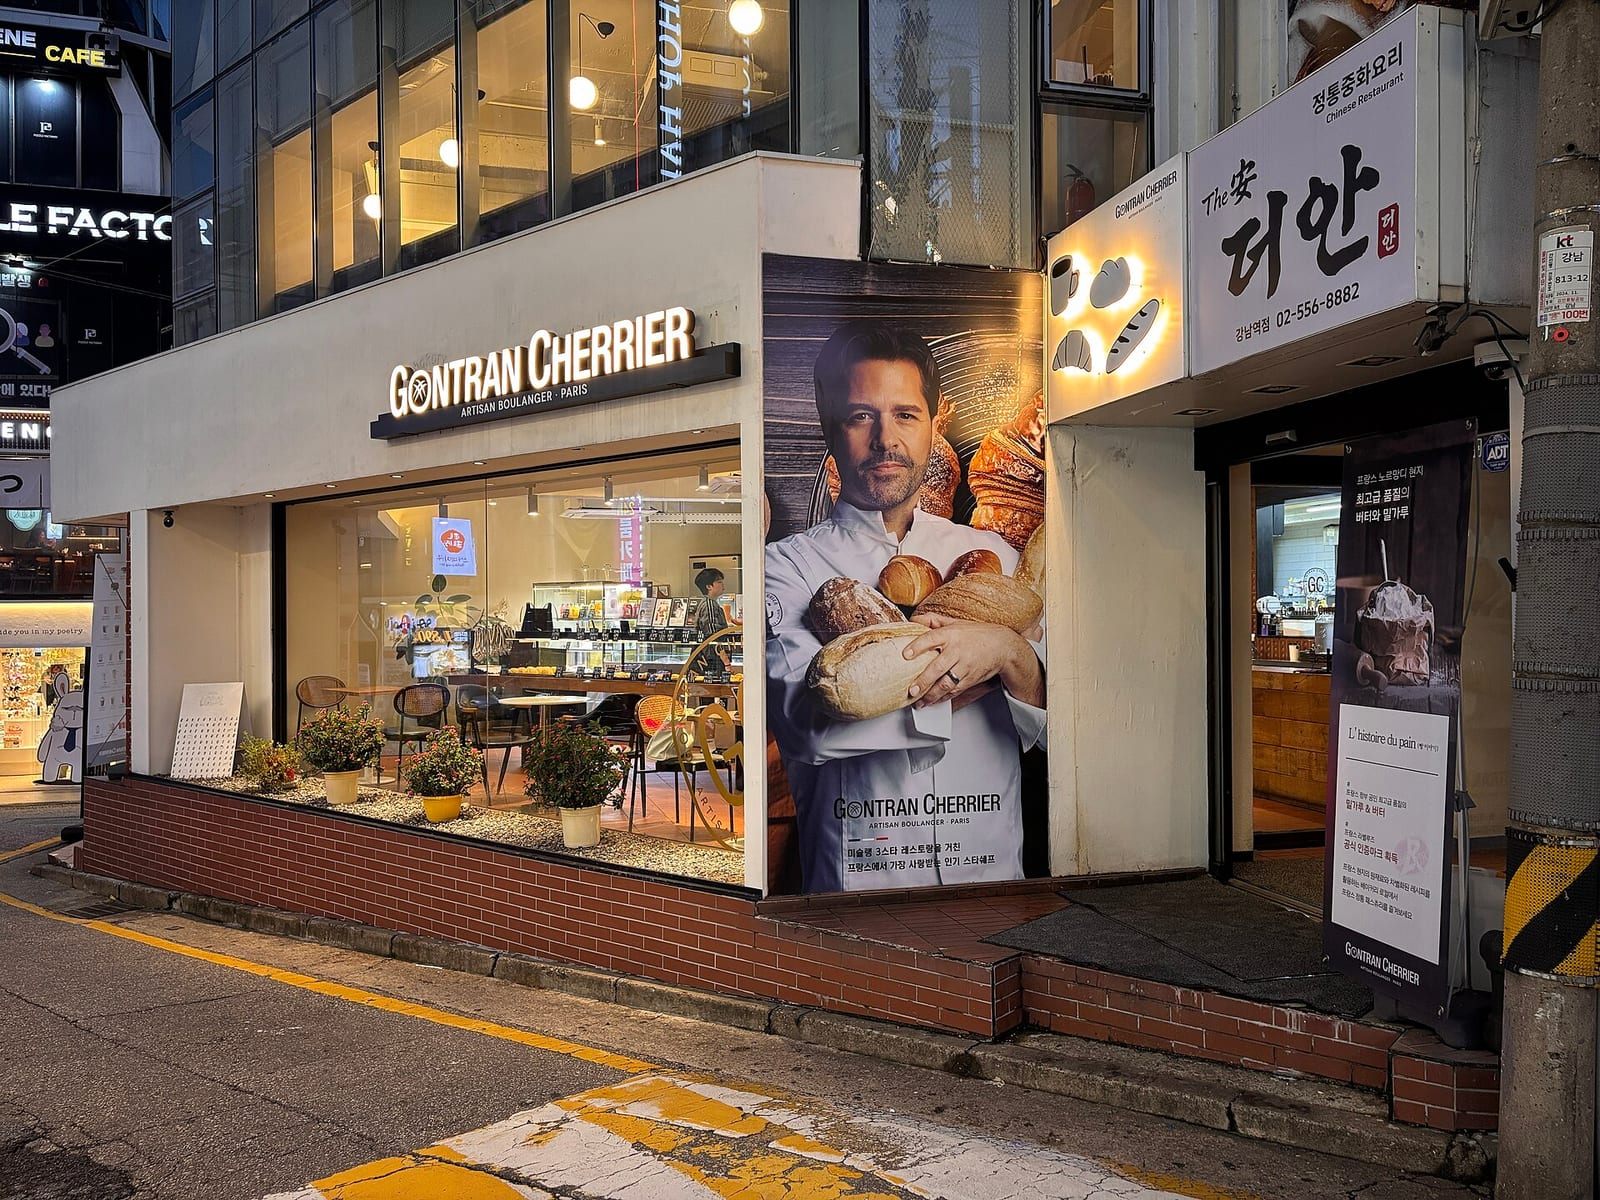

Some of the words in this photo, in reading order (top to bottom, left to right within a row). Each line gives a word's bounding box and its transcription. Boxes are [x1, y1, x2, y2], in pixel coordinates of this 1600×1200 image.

[45, 45, 105, 67] CAFE
[1312, 41, 1402, 115] 정통중화요리
[1326, 100, 1357, 124] Chinese
[1358, 72, 1404, 106] Restaurant
[1115, 190, 1145, 219] GONTRAN
[1146, 170, 1177, 200] CHERRIER
[1202, 187, 1228, 217] The
[47, 206, 213, 245] FACTO
[1221, 144, 1380, 299] 더안
[1381, 208, 1397, 252] 더안
[1556, 235, 1574, 248] kt
[1561, 251, 1584, 263] 강남
[0, 273, 31, 288] 발생
[1555, 274, 1588, 284] 813-12
[1275, 281, 1361, 328] 02-556-8882
[1561, 310, 1588, 319] 100번
[1235, 316, 1271, 343] 강남역점
[389, 345, 522, 418] GONTRAN
[528, 305, 695, 390] CHERRIER
[461, 400, 496, 418] ARTISAN
[498, 391, 553, 411] BOULANGER
[561, 383, 588, 399] PARIS
[1, 422, 51, 440] EN
[1487, 444, 1509, 461] ADT
[1356, 474, 1378, 485] 프랑스
[1378, 467, 1408, 482] 노르망디
[1408, 465, 1424, 479] 현지
[1356, 491, 1381, 505] 최고급
[1383, 486, 1410, 503] 품질의
[1355, 508, 1382, 524] 버터와
[1383, 505, 1409, 522] 밀가루
[1308, 576, 1324, 593] GC
[57, 628, 84, 636] poetry
[1387, 733, 1398, 746] du
[1398, 736, 1417, 750] pain
[833, 797, 919, 820] GONTRAN
[923, 793, 1001, 815] CHERRIER
[1346, 798, 1365, 813] 밀가루
[1365, 804, 1371, 814] &
[1372, 805, 1386, 818] 버터
[869, 821, 899, 829] ARTISAN
[901, 819, 945, 828] BOULANGER
[847, 847, 873, 859] 미슐랭
[875, 846, 898, 857] 3스타
[901, 843, 941, 855] 레스토랑을
[945, 842, 961, 852] 거친
[1344, 838, 1357, 851] 공식
[1357, 842, 1383, 859] 인증마크
[847, 861, 888, 873] 프랑스에서
[889, 860, 906, 870] 가장
[908, 858, 941, 870] 사랑받는
[944, 857, 960, 867] 인기
[1345, 941, 1382, 969] GONTRAN
[1382, 957, 1420, 986] CHERRIER
